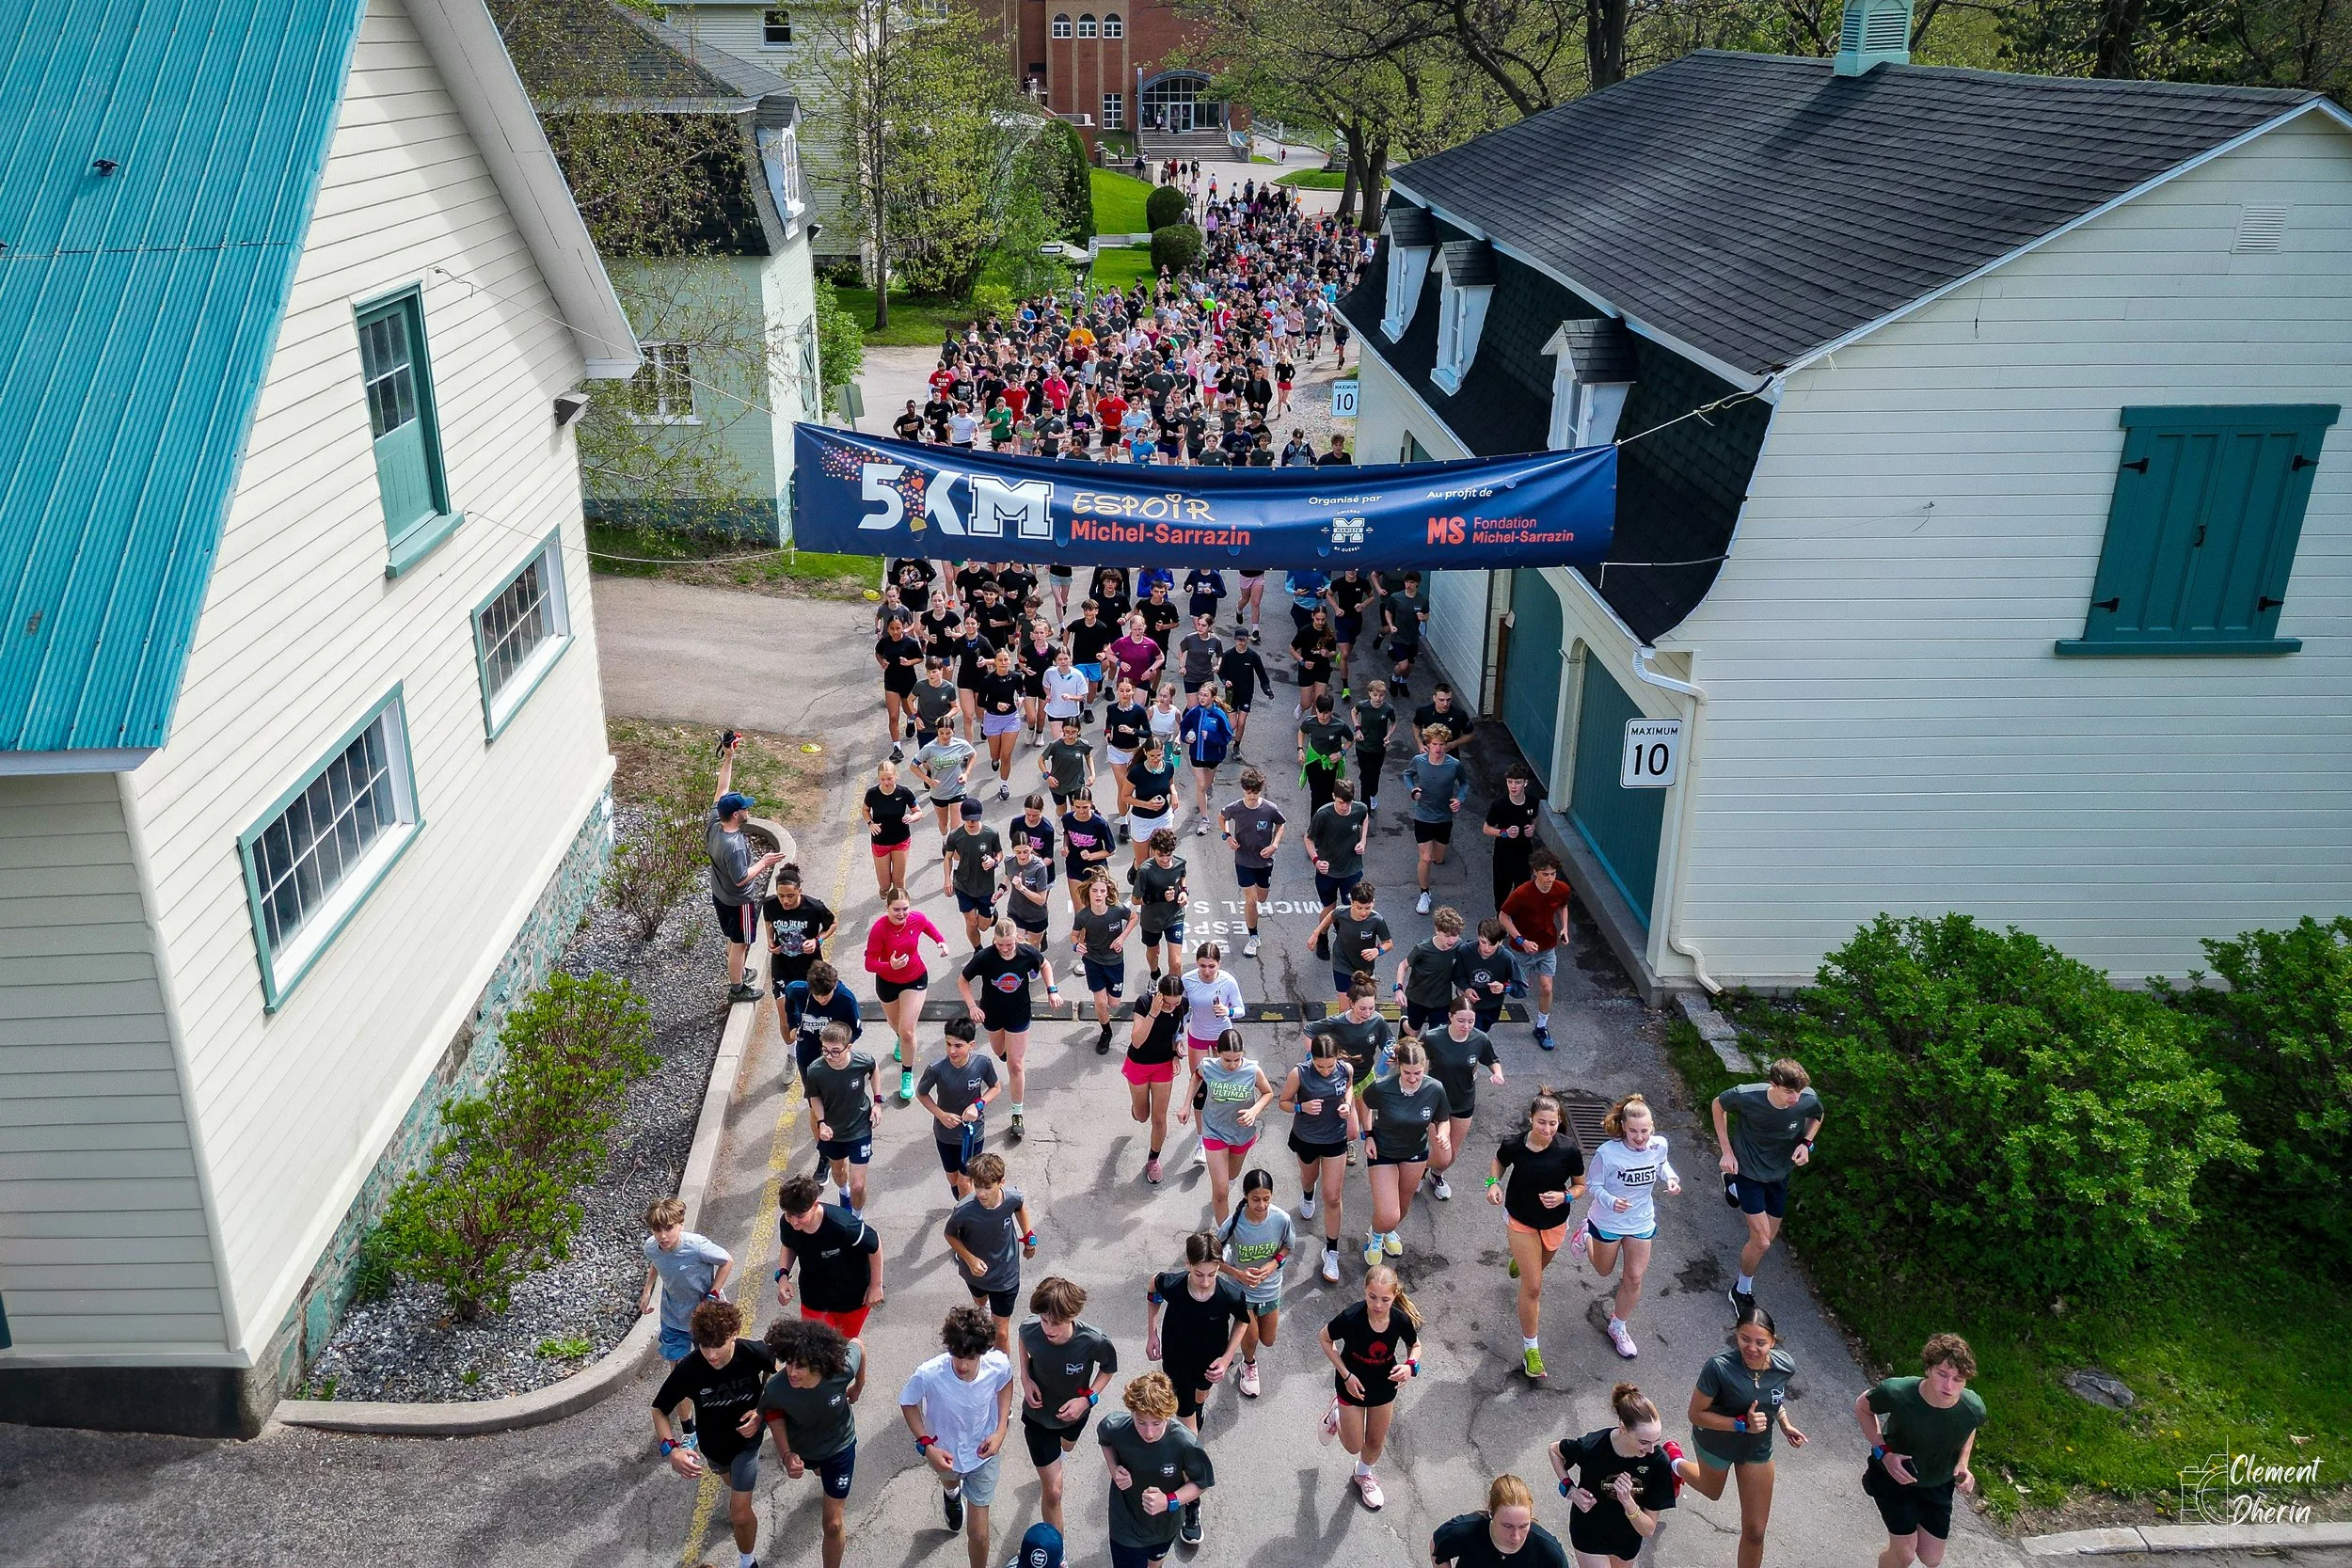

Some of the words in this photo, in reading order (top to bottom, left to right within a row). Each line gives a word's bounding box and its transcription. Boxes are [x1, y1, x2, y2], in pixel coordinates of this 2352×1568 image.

[1337, 393, 1354, 410] 10
[1309, 496, 1359, 506] Organisé
[1361, 495, 1383, 504] par
[1426, 490, 1443, 499] Au
[1444, 487, 1477, 500] profit
[1478, 488, 1493, 498] de
[1072, 492, 1216, 522] ESPOIR
[1473, 516, 1537, 530] Fondation
[1071, 519, 1251, 546] Michel-Sarrazin
[1427, 516, 1467, 545] MS
[1472, 529, 1575, 544] Michel-Sarrazin
[1630, 727, 1678, 736] MAXIMUM
[1634, 743, 1670, 776] 10
[772, 919, 788, 929] COLD
[788, 919, 808, 929] HEART
[1210, 1081, 1248, 1092] MARISTE
